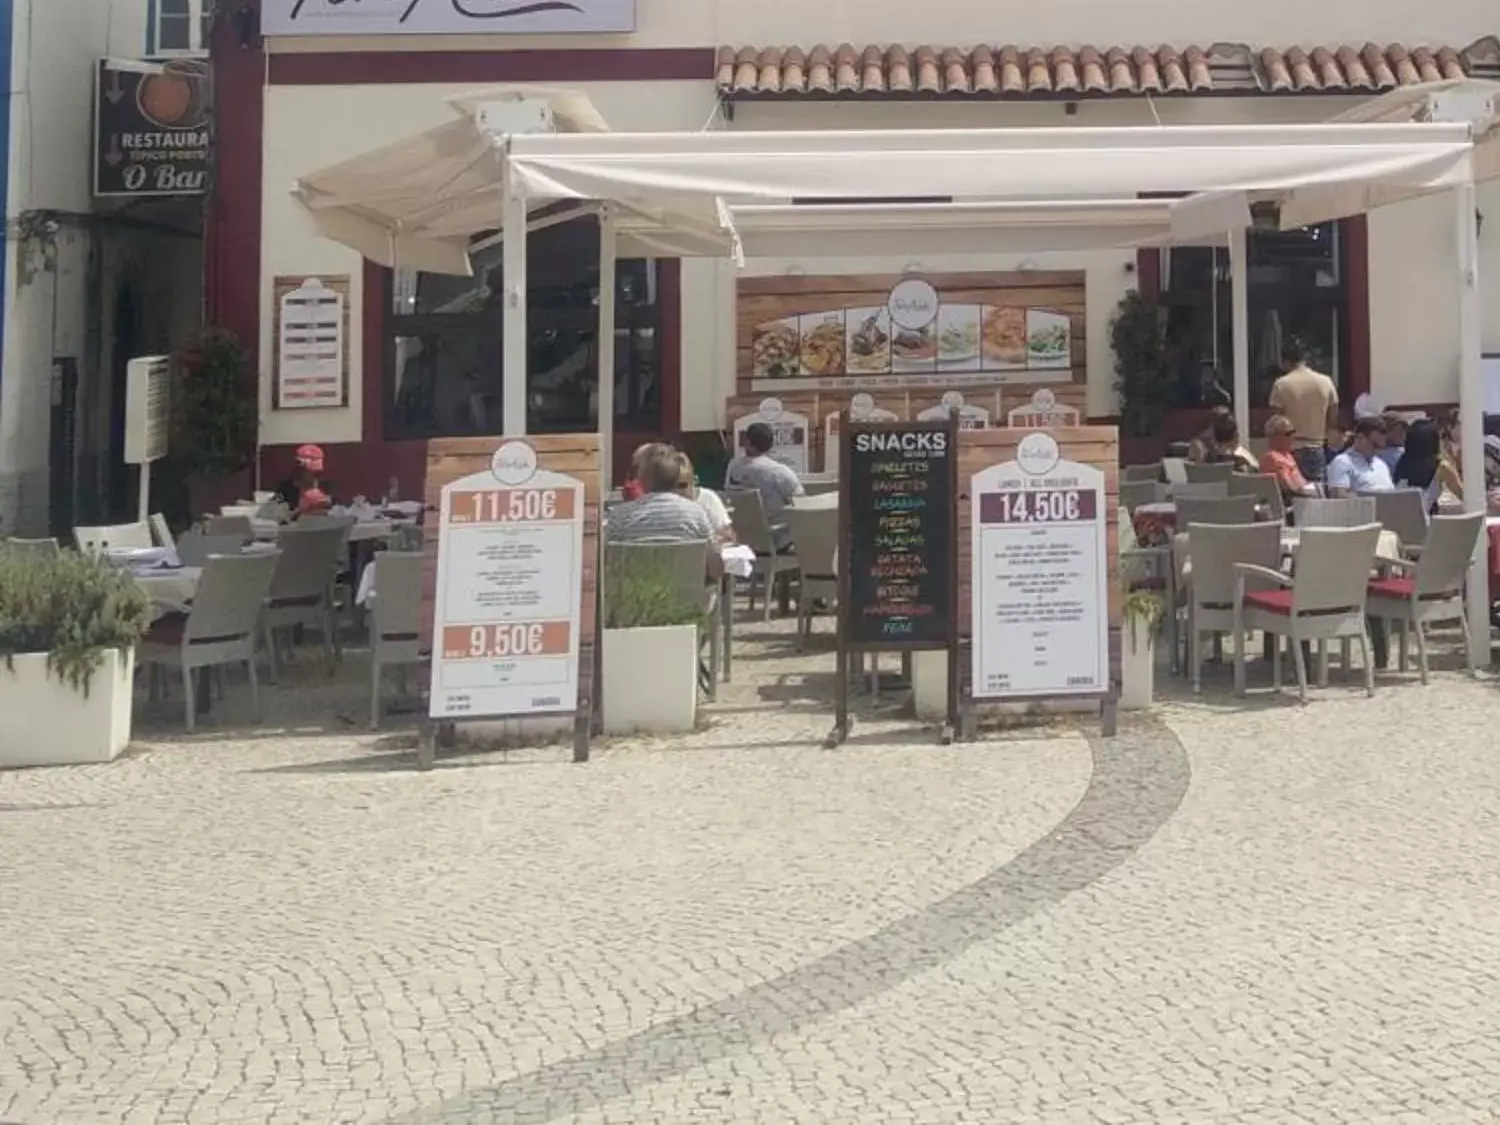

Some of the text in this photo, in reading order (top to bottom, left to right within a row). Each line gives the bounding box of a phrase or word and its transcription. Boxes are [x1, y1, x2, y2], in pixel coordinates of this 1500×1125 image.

[856, 432, 947, 452] SNACKS
[472, 490, 557, 522] 11.50€
[1000, 491, 1080, 522] 14.50€
[470, 624, 544, 657] 9.50€
